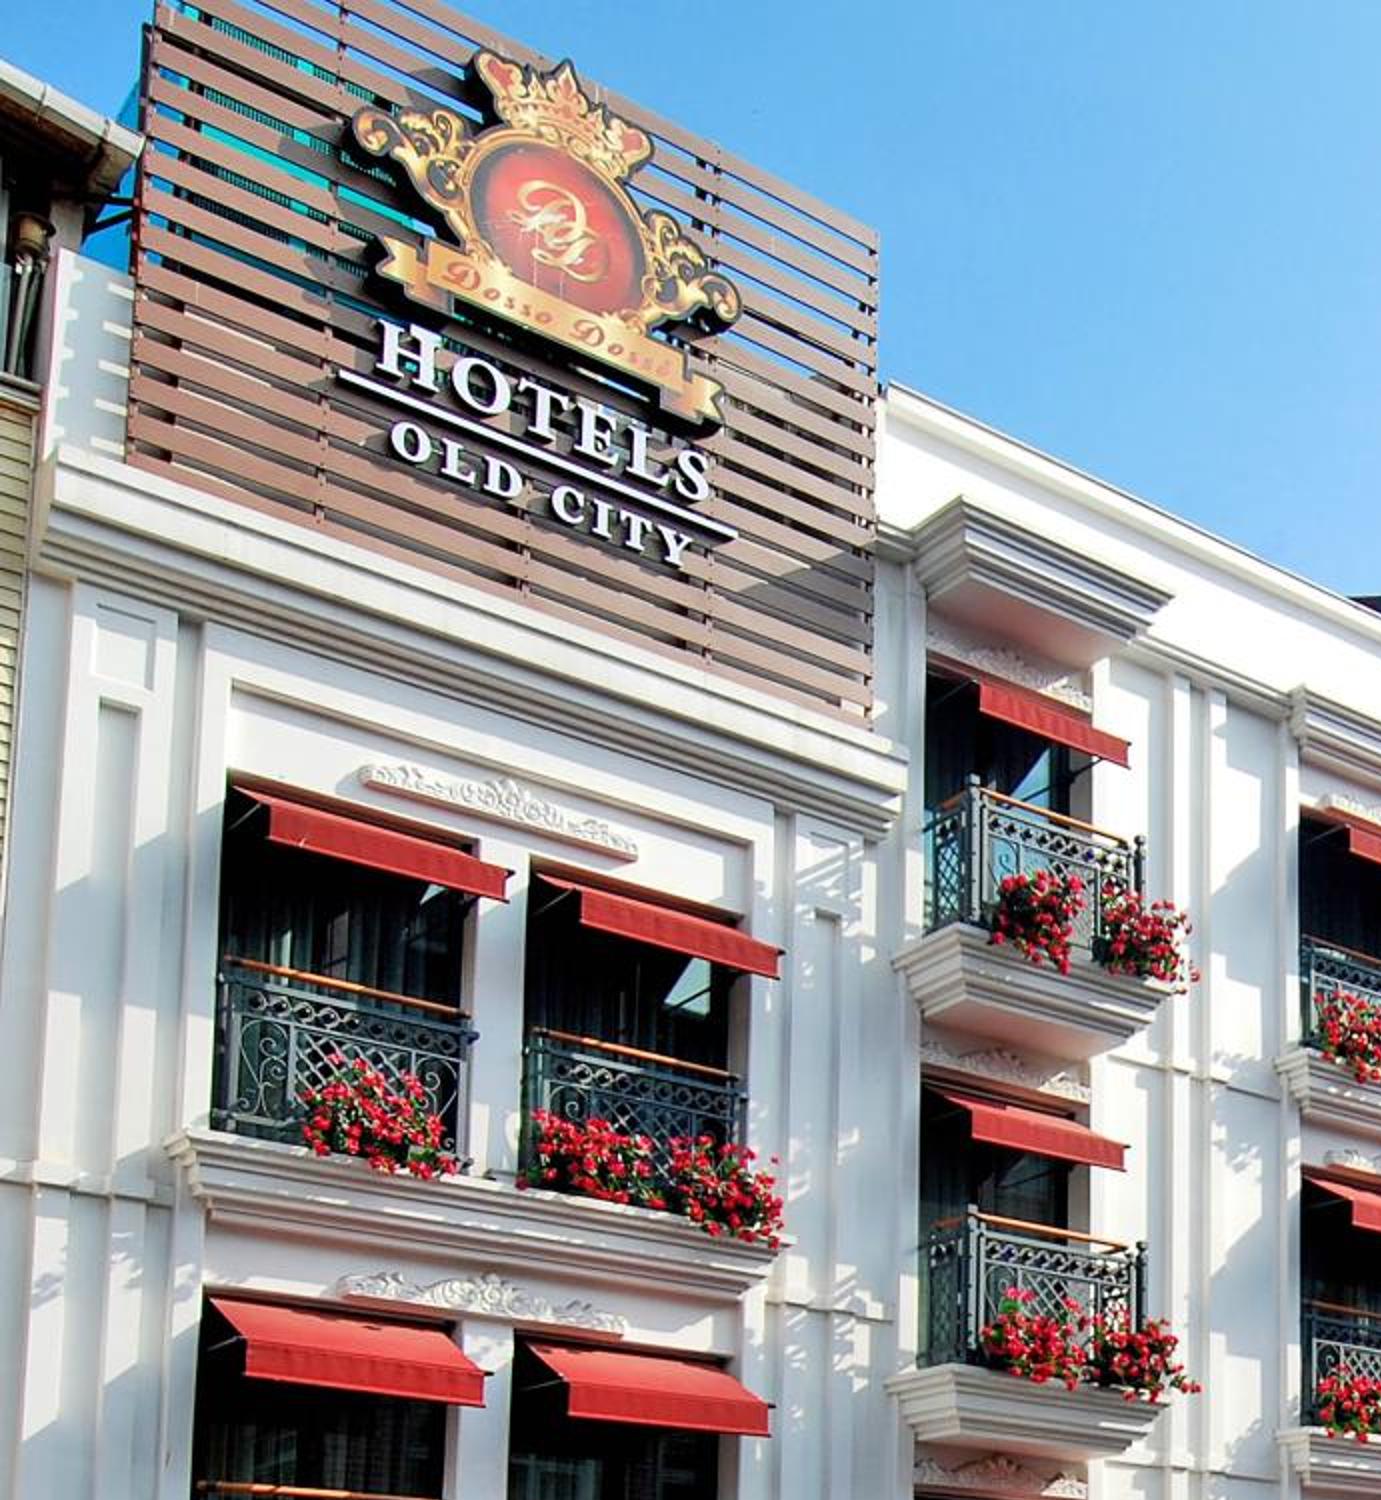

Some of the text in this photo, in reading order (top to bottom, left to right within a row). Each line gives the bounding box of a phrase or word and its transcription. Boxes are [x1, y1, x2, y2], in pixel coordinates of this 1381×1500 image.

[442, 261, 553, 325] Dosso
[375, 318, 711, 502] HOTELS
[390, 421, 694, 568] OLD CITY
